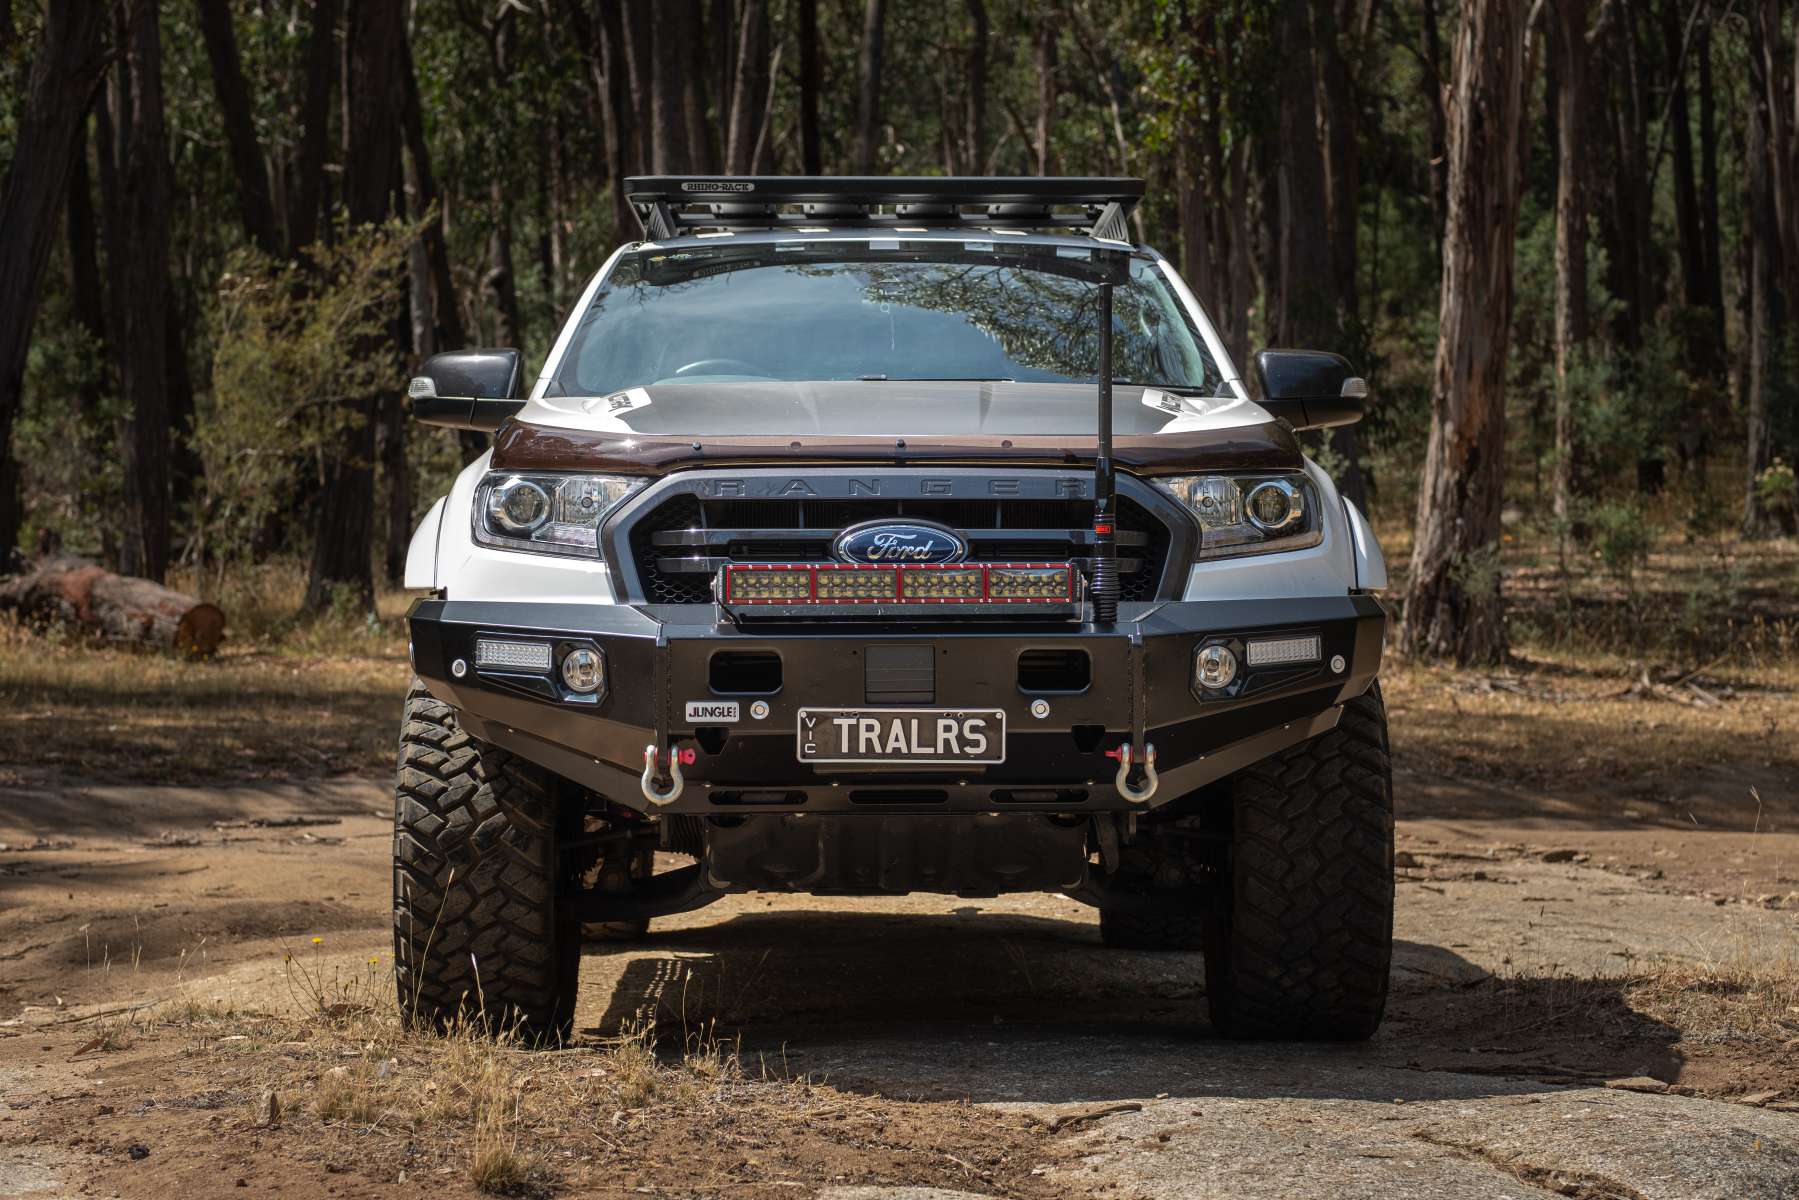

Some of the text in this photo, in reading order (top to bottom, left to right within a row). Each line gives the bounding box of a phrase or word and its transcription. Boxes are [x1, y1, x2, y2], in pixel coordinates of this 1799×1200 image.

[687, 183, 750, 191] RHINO-RACK
[715, 479, 1087, 497] RANGER
[866, 532, 934, 560] Ford
[688, 706, 733, 718] JUNGLE
[804, 717, 817, 754] VIC
[832, 718, 988, 755] TRALRS
